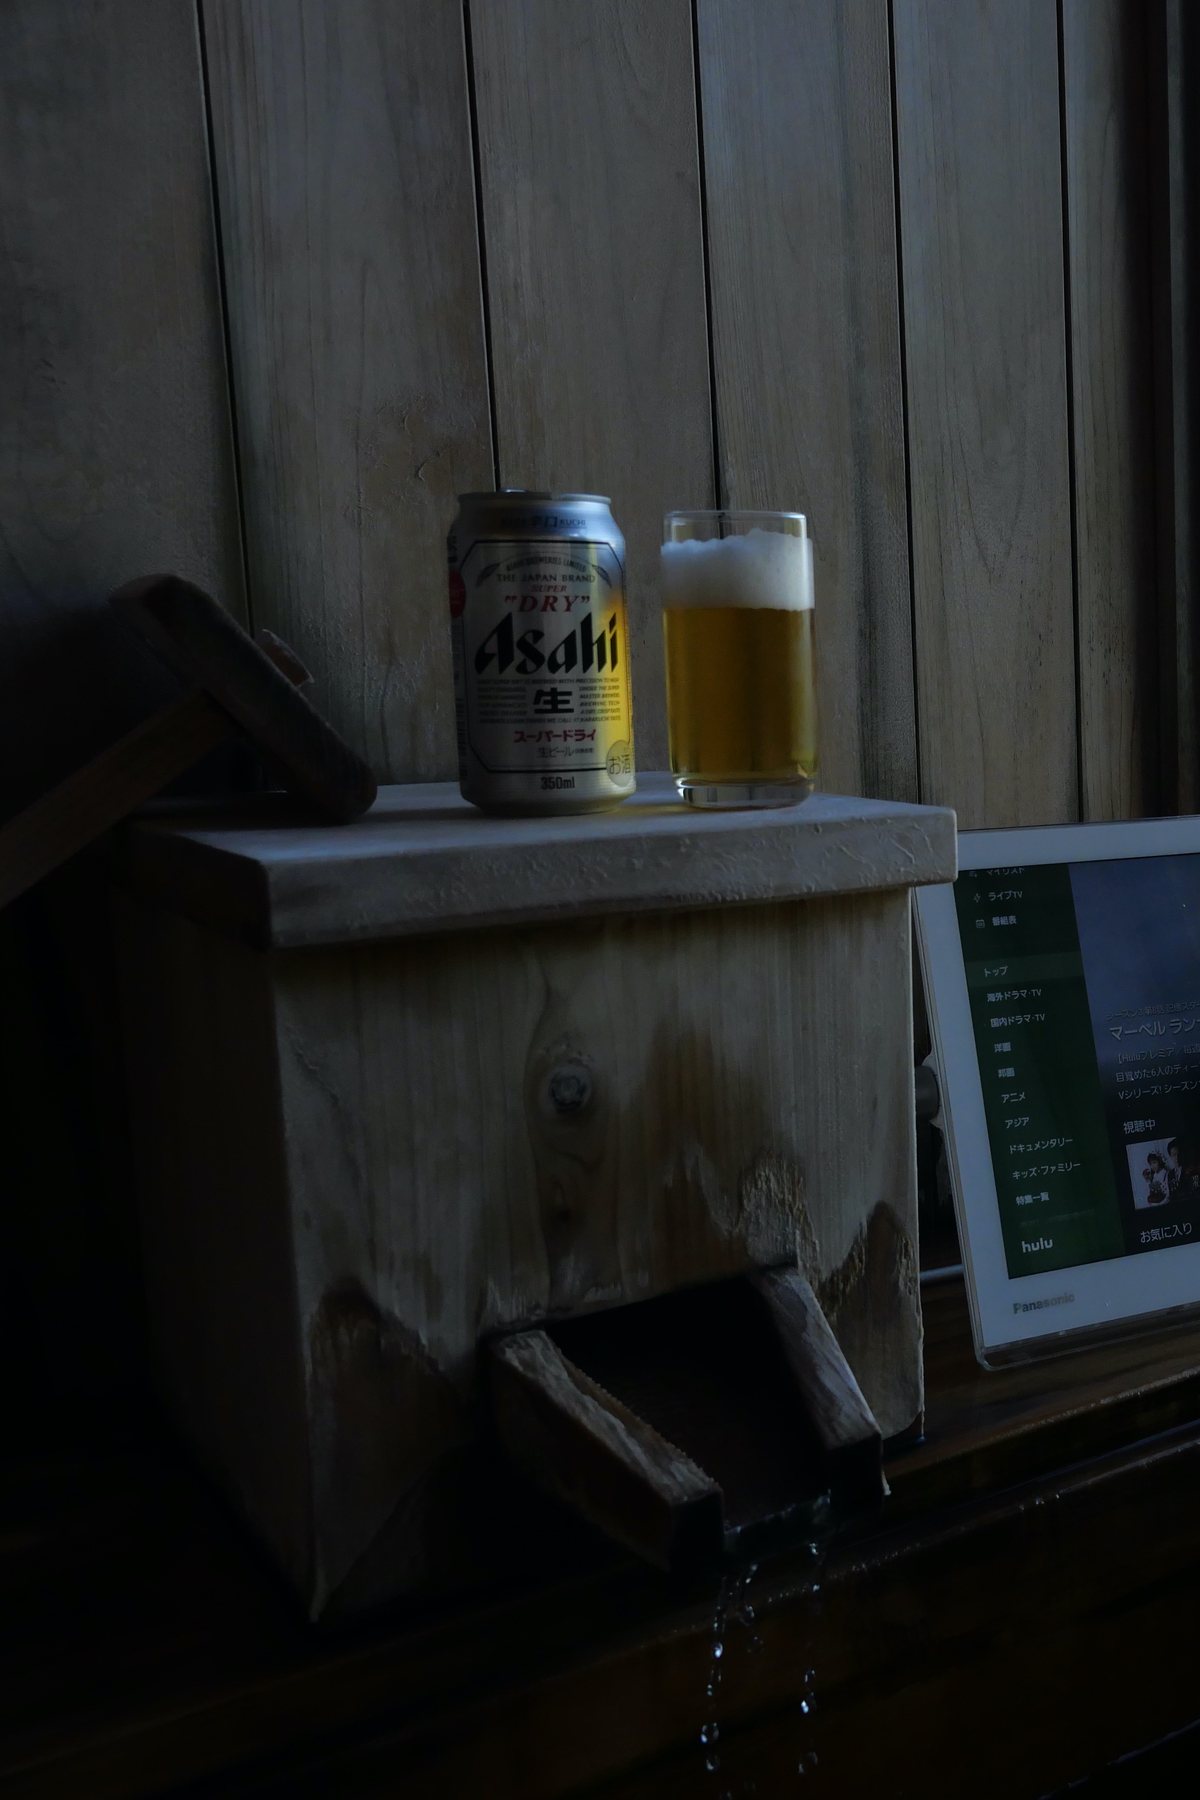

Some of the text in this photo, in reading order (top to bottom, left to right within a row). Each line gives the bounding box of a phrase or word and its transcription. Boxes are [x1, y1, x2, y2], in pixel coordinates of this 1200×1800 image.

[496, 573, 596, 583] THE JAPAN BRAND
[474, 612, 618, 675] Asahi
[532, 687, 575, 714] 生
[513, 729, 597, 744] スーパードライ
[541, 776, 575, 790] 350ml
[988, 890, 1023, 901] ライブTV
[984, 965, 1008, 977] トップ
[1109, 1020, 1166, 1041] マーベル
[1001, 1091, 1026, 1104] アニメ
[1005, 1116, 1030, 1129] アジア
[1123, 1118, 1156, 1135] 視聴中
[1009, 1137, 1073, 1155] ドキュメンタリー
[1139, 1222, 1193, 1244] お気に入り
[1022, 1236, 1054, 1254] hulu
[1012, 1291, 1076, 1315] Panasonic
